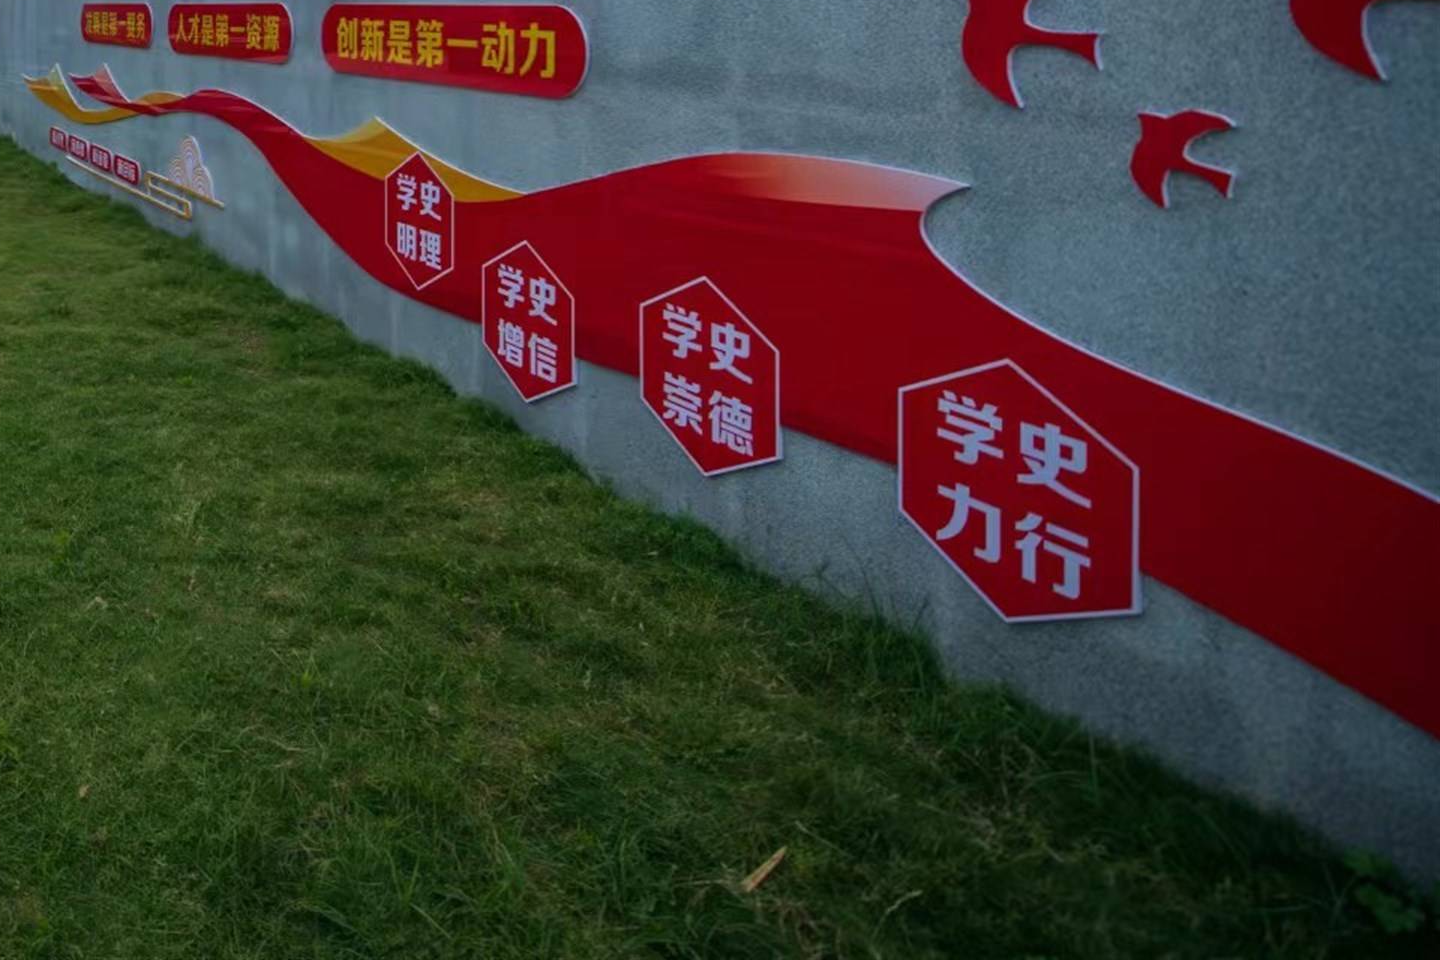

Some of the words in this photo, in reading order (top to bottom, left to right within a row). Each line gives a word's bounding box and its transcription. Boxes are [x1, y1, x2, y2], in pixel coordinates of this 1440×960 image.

[175, 14, 280, 52] 人才是第一资源
[337, 19, 556, 80] 创新是第一动力
[397, 173, 442, 221] 学史
[397, 222, 442, 270] 明理
[498, 263, 557, 326] 学史
[498, 318, 558, 383] 增信
[662, 303, 753, 385] 学史
[662, 372, 754, 458] 崇德
[937, 390, 1091, 510] 学史
[937, 483, 1091, 601] 力行
